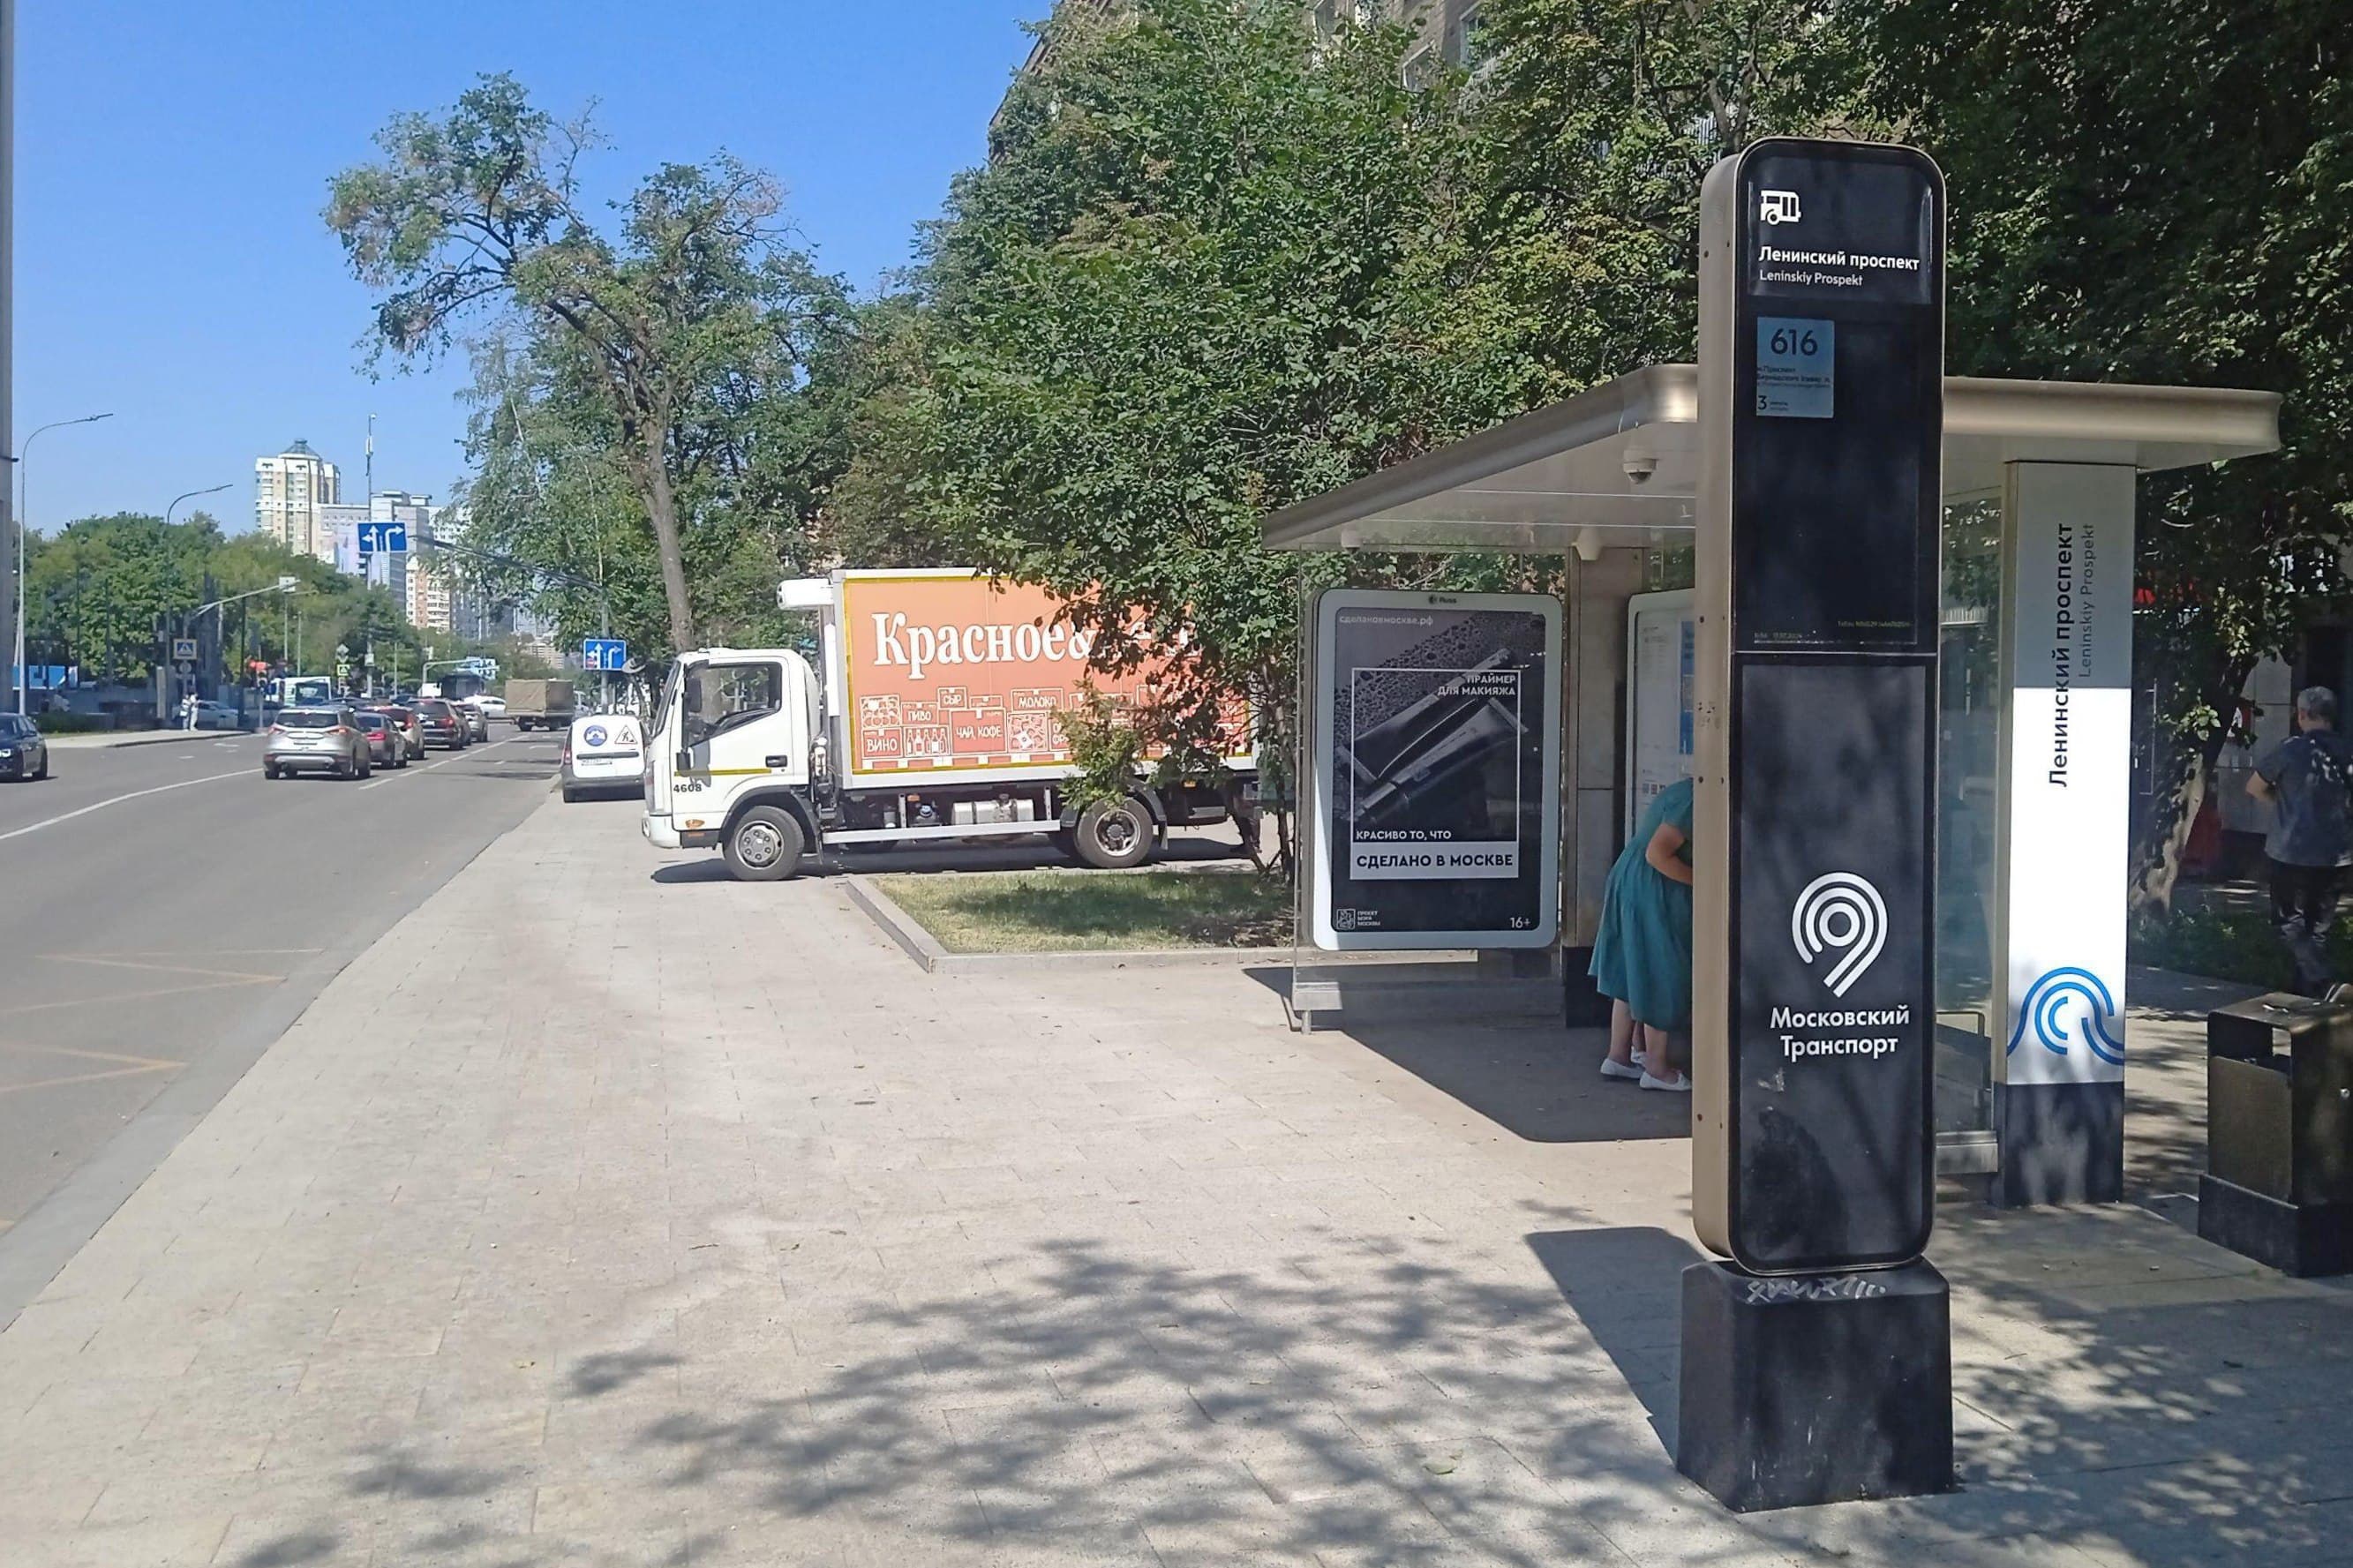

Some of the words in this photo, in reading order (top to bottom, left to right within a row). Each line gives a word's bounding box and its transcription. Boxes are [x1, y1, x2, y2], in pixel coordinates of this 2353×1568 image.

[1758, 245, 1846, 266] Ленинский
[1849, 254, 1920, 271] проспект
[1760, 269, 1812, 286] Leninskiy
[1815, 272, 1863, 287] Prospekt
[1770, 328, 1817, 356] 616
[1758, 394, 1767, 409] 3
[2080, 522, 2096, 596] Prospekt
[2055, 522, 2074, 640] проспект
[2079, 600, 2095, 678] Leninskiy
[1467, 672, 1515, 684] ПРАЙМЕР
[1438, 686, 1459, 696] ДЛЯ
[1462, 686, 1515, 695] МАКИЯЖА
[943, 694, 962, 705] СЫР
[1019, 695, 1056, 707] МОЛОКО
[907, 709, 932, 722] ПИВО
[2049, 648, 2071, 787] Ленинский
[977, 725, 1003, 739] КОФЕ
[866, 738, 898, 752] ВИНО
[673, 784, 702, 792] 4608
[1356, 830, 1407, 839] КРАСИВО
[1410, 830, 1427, 840] ТО,
[1430, 830, 1451, 839] ЧТО
[1356, 855, 1432, 869] СДЕЛАНО
[1436, 855, 1446, 867] В
[1450, 854, 1514, 867] МОСКВЕ
[1510, 917, 1531, 928] 16+
[1770, 1004, 1910, 1029] Московский
[1780, 1035, 1898, 1063] Транспорт
